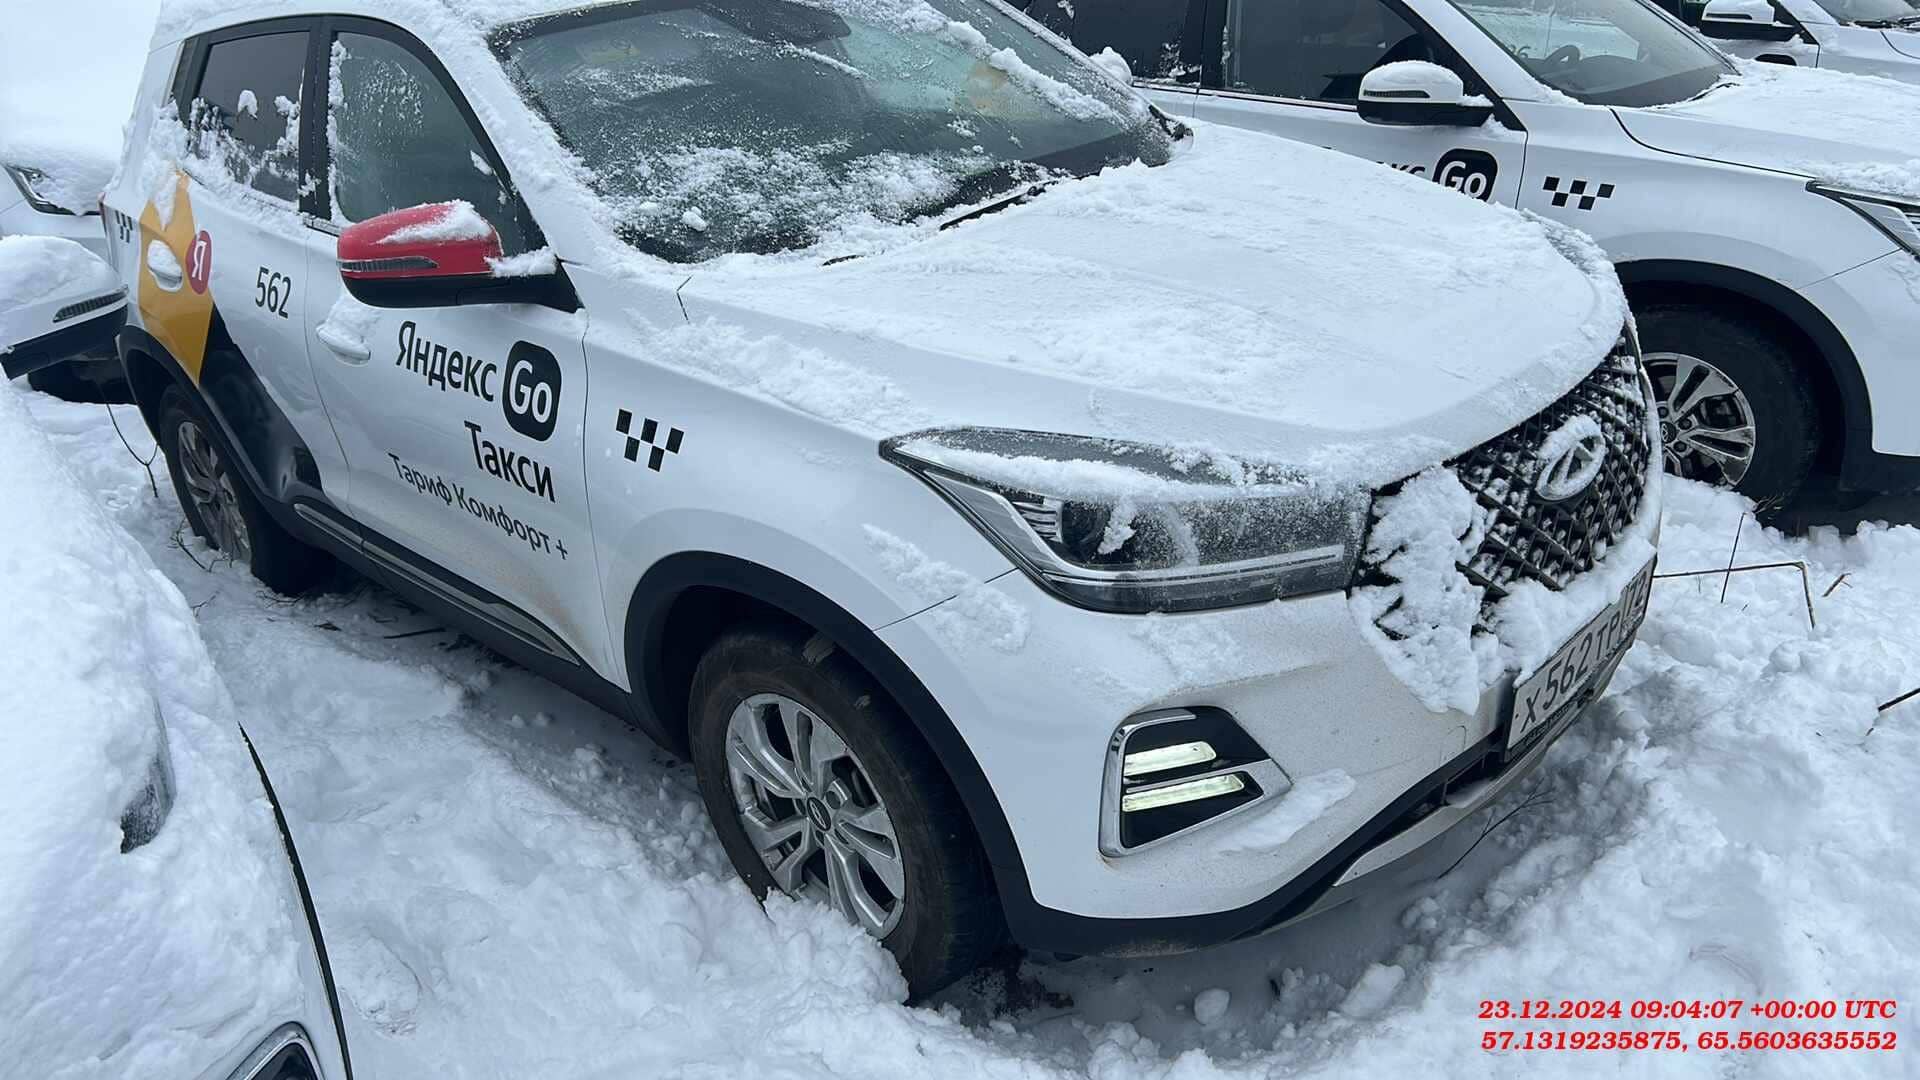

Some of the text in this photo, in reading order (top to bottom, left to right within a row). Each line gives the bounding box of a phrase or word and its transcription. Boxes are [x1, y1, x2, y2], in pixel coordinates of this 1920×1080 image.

[1439, 160, 1487, 199] Go
[192, 239, 207, 280] Я
[255, 266, 291, 319] 562
[396, 320, 553, 423] Яндекс Go
[388, 452, 452, 506] Тариф
[463, 420, 556, 503] Такси
